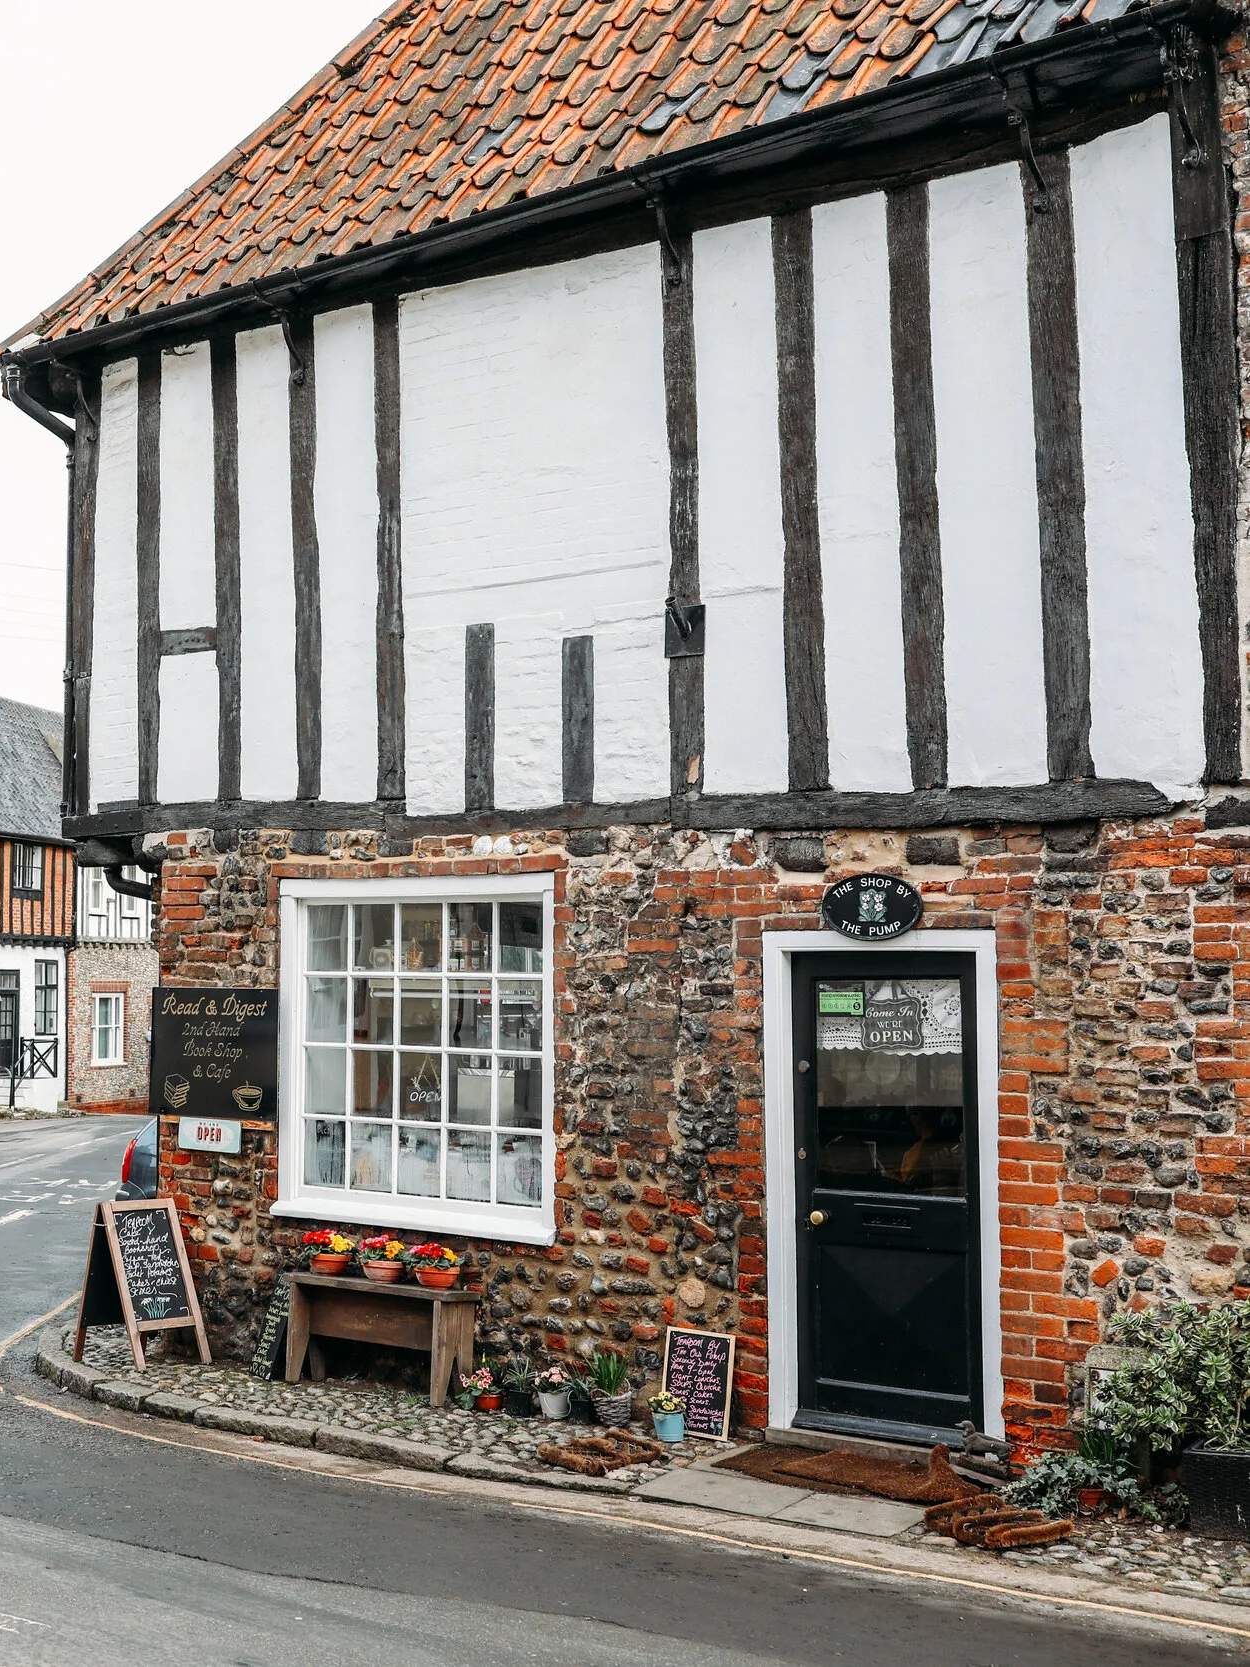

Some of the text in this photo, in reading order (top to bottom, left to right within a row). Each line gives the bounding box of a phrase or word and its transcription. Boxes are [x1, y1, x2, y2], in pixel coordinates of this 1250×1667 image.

[832, 877, 912, 899] THE SHOP BY
[840, 920, 901, 936] THE PUMP
[161, 992, 268, 1023] Read & Digest
[865, 1006, 895, 1018] Come
[897, 1005, 914, 1017] In
[182, 1021, 244, 1037] 2nd Hand
[869, 1030, 914, 1043] OPEN
[183, 1038, 242, 1063] Book Shop
[193, 1063, 232, 1084] & Cafe
[197, 1126, 222, 1142] OPEN
